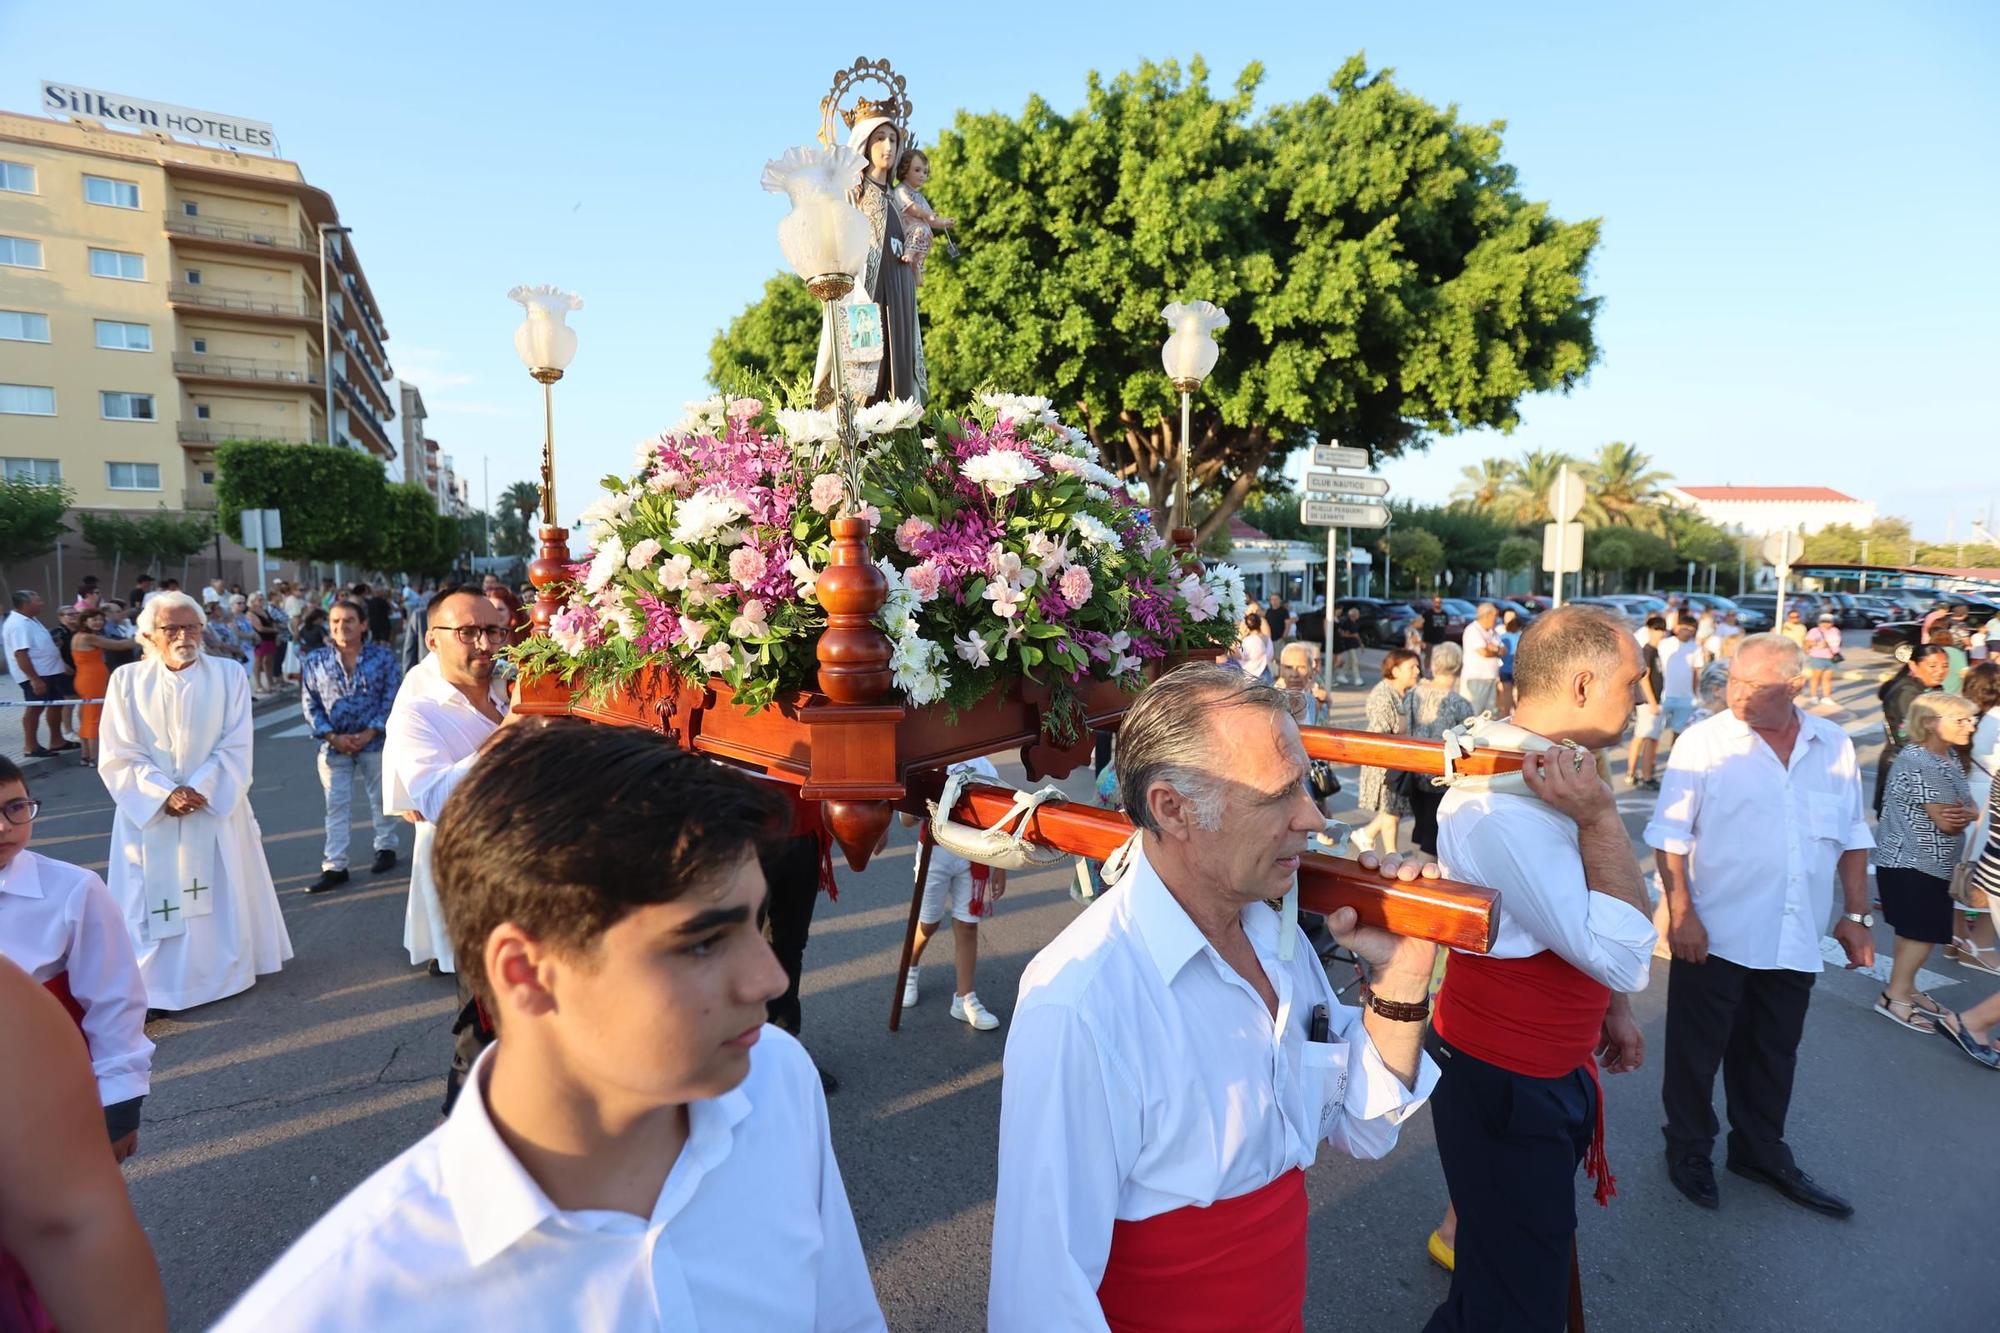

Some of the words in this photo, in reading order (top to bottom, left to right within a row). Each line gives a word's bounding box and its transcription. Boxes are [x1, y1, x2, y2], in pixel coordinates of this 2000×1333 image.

[46, 85, 159, 127] Silken
[167, 113, 271, 147] HOTELES
[1312, 479, 1331, 487] CLUB
